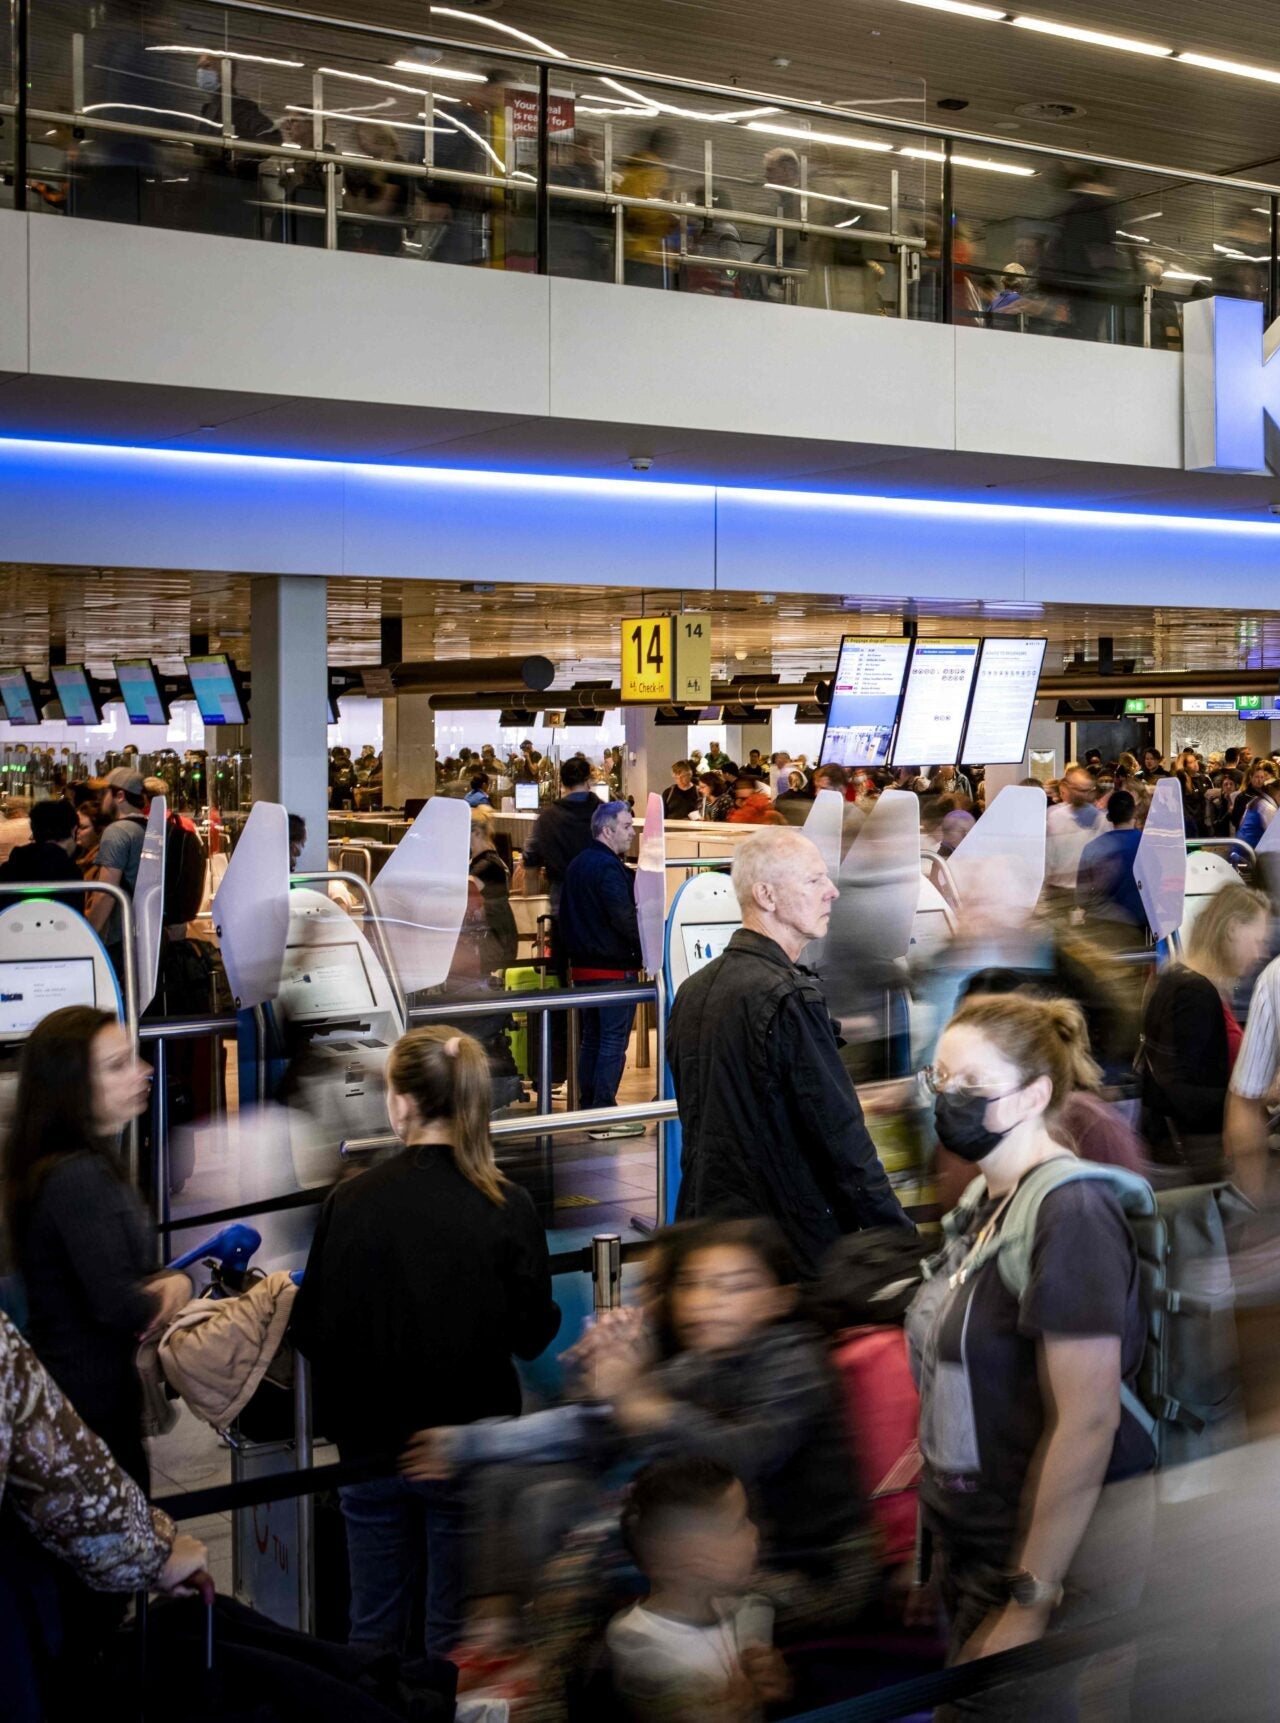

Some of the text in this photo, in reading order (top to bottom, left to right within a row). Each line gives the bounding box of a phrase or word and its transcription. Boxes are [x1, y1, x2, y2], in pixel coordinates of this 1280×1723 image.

[514, 99, 536, 111] Your
[513, 110, 522, 120] is
[552, 115, 567, 127] for
[685, 623, 703, 638] 14
[631, 624, 664, 674] 14
[639, 681, 665, 693] Check-in
